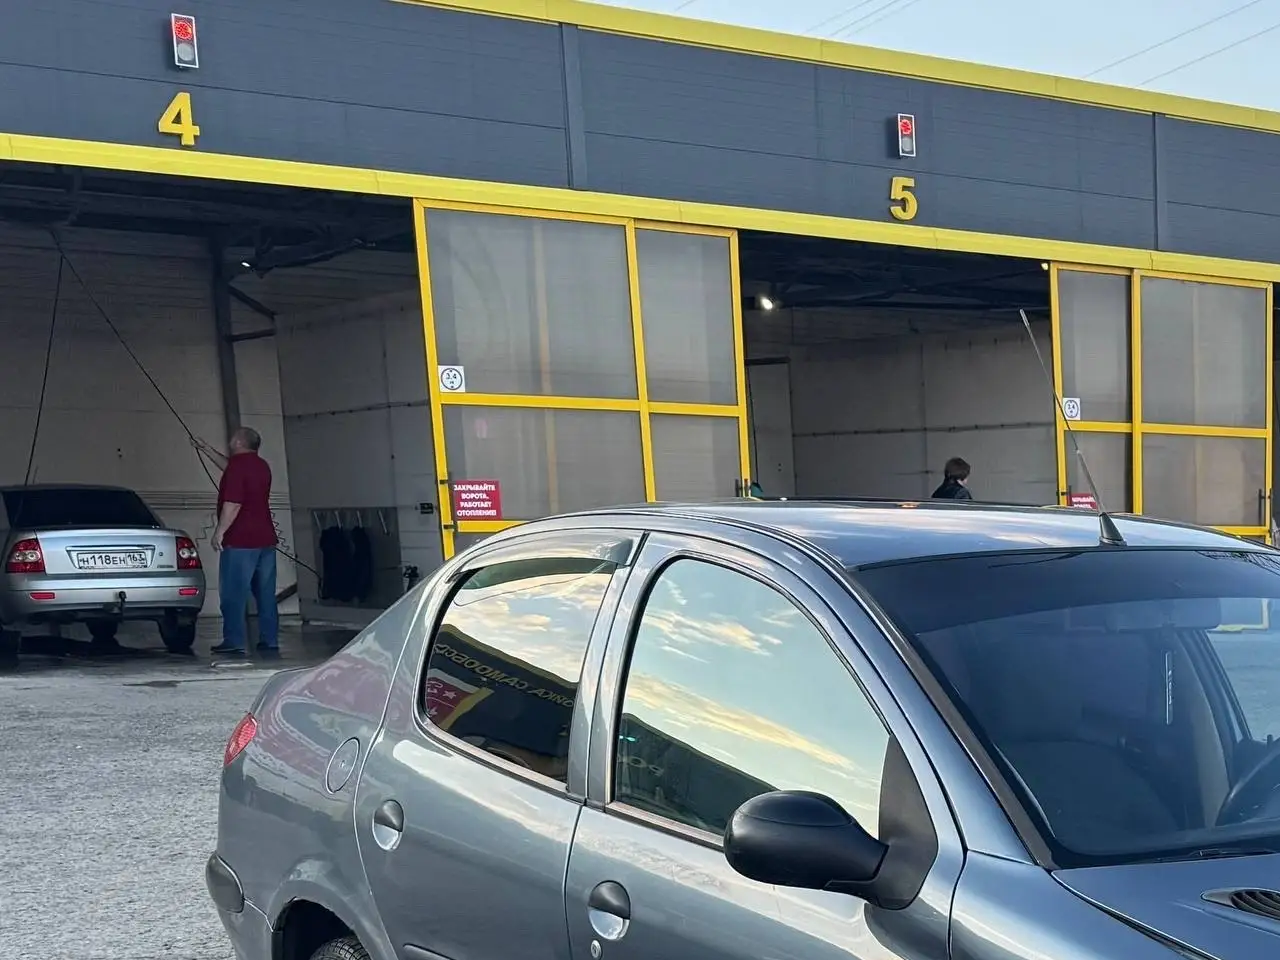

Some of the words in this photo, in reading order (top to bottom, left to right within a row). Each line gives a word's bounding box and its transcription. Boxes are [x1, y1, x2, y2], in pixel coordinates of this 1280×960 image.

[159, 92, 200, 146] 4
[890, 176, 918, 220] 5
[453, 483, 496, 491] ЗАКРЫВАЙТЕ
